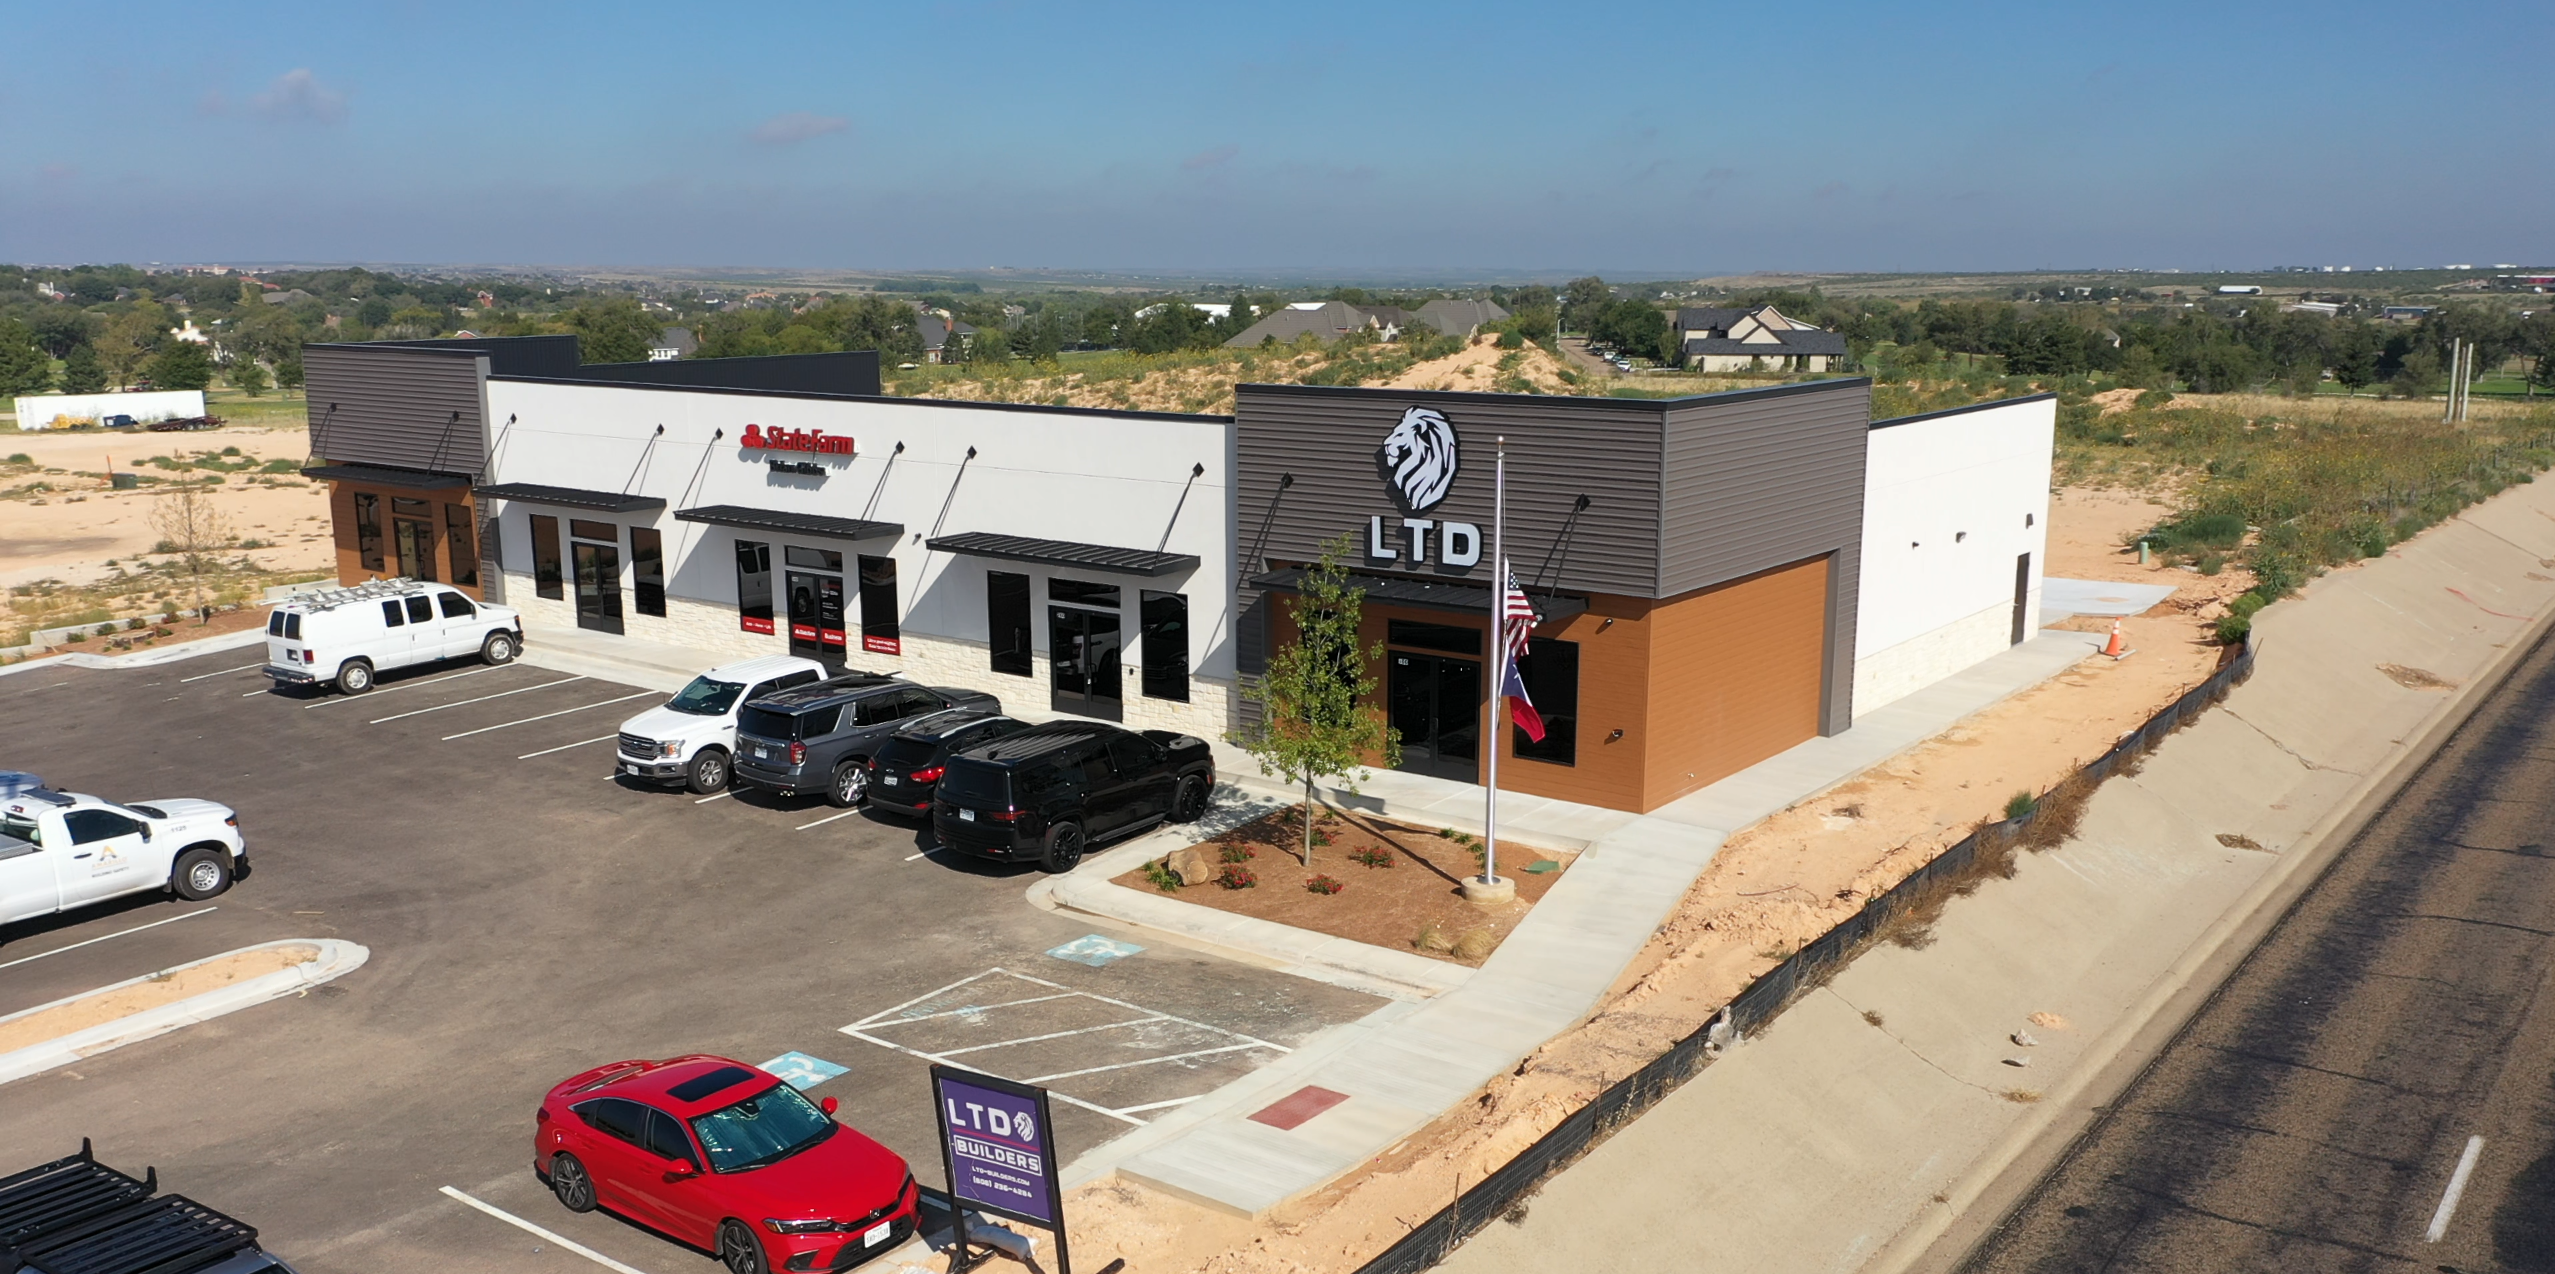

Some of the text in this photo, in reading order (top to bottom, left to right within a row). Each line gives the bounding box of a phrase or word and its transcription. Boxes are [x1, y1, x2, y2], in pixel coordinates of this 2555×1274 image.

[1371, 515, 1482, 567] LTD
[948, 1098, 1011, 1136] LTD
[957, 1139, 1039, 1171] BUILDERS
